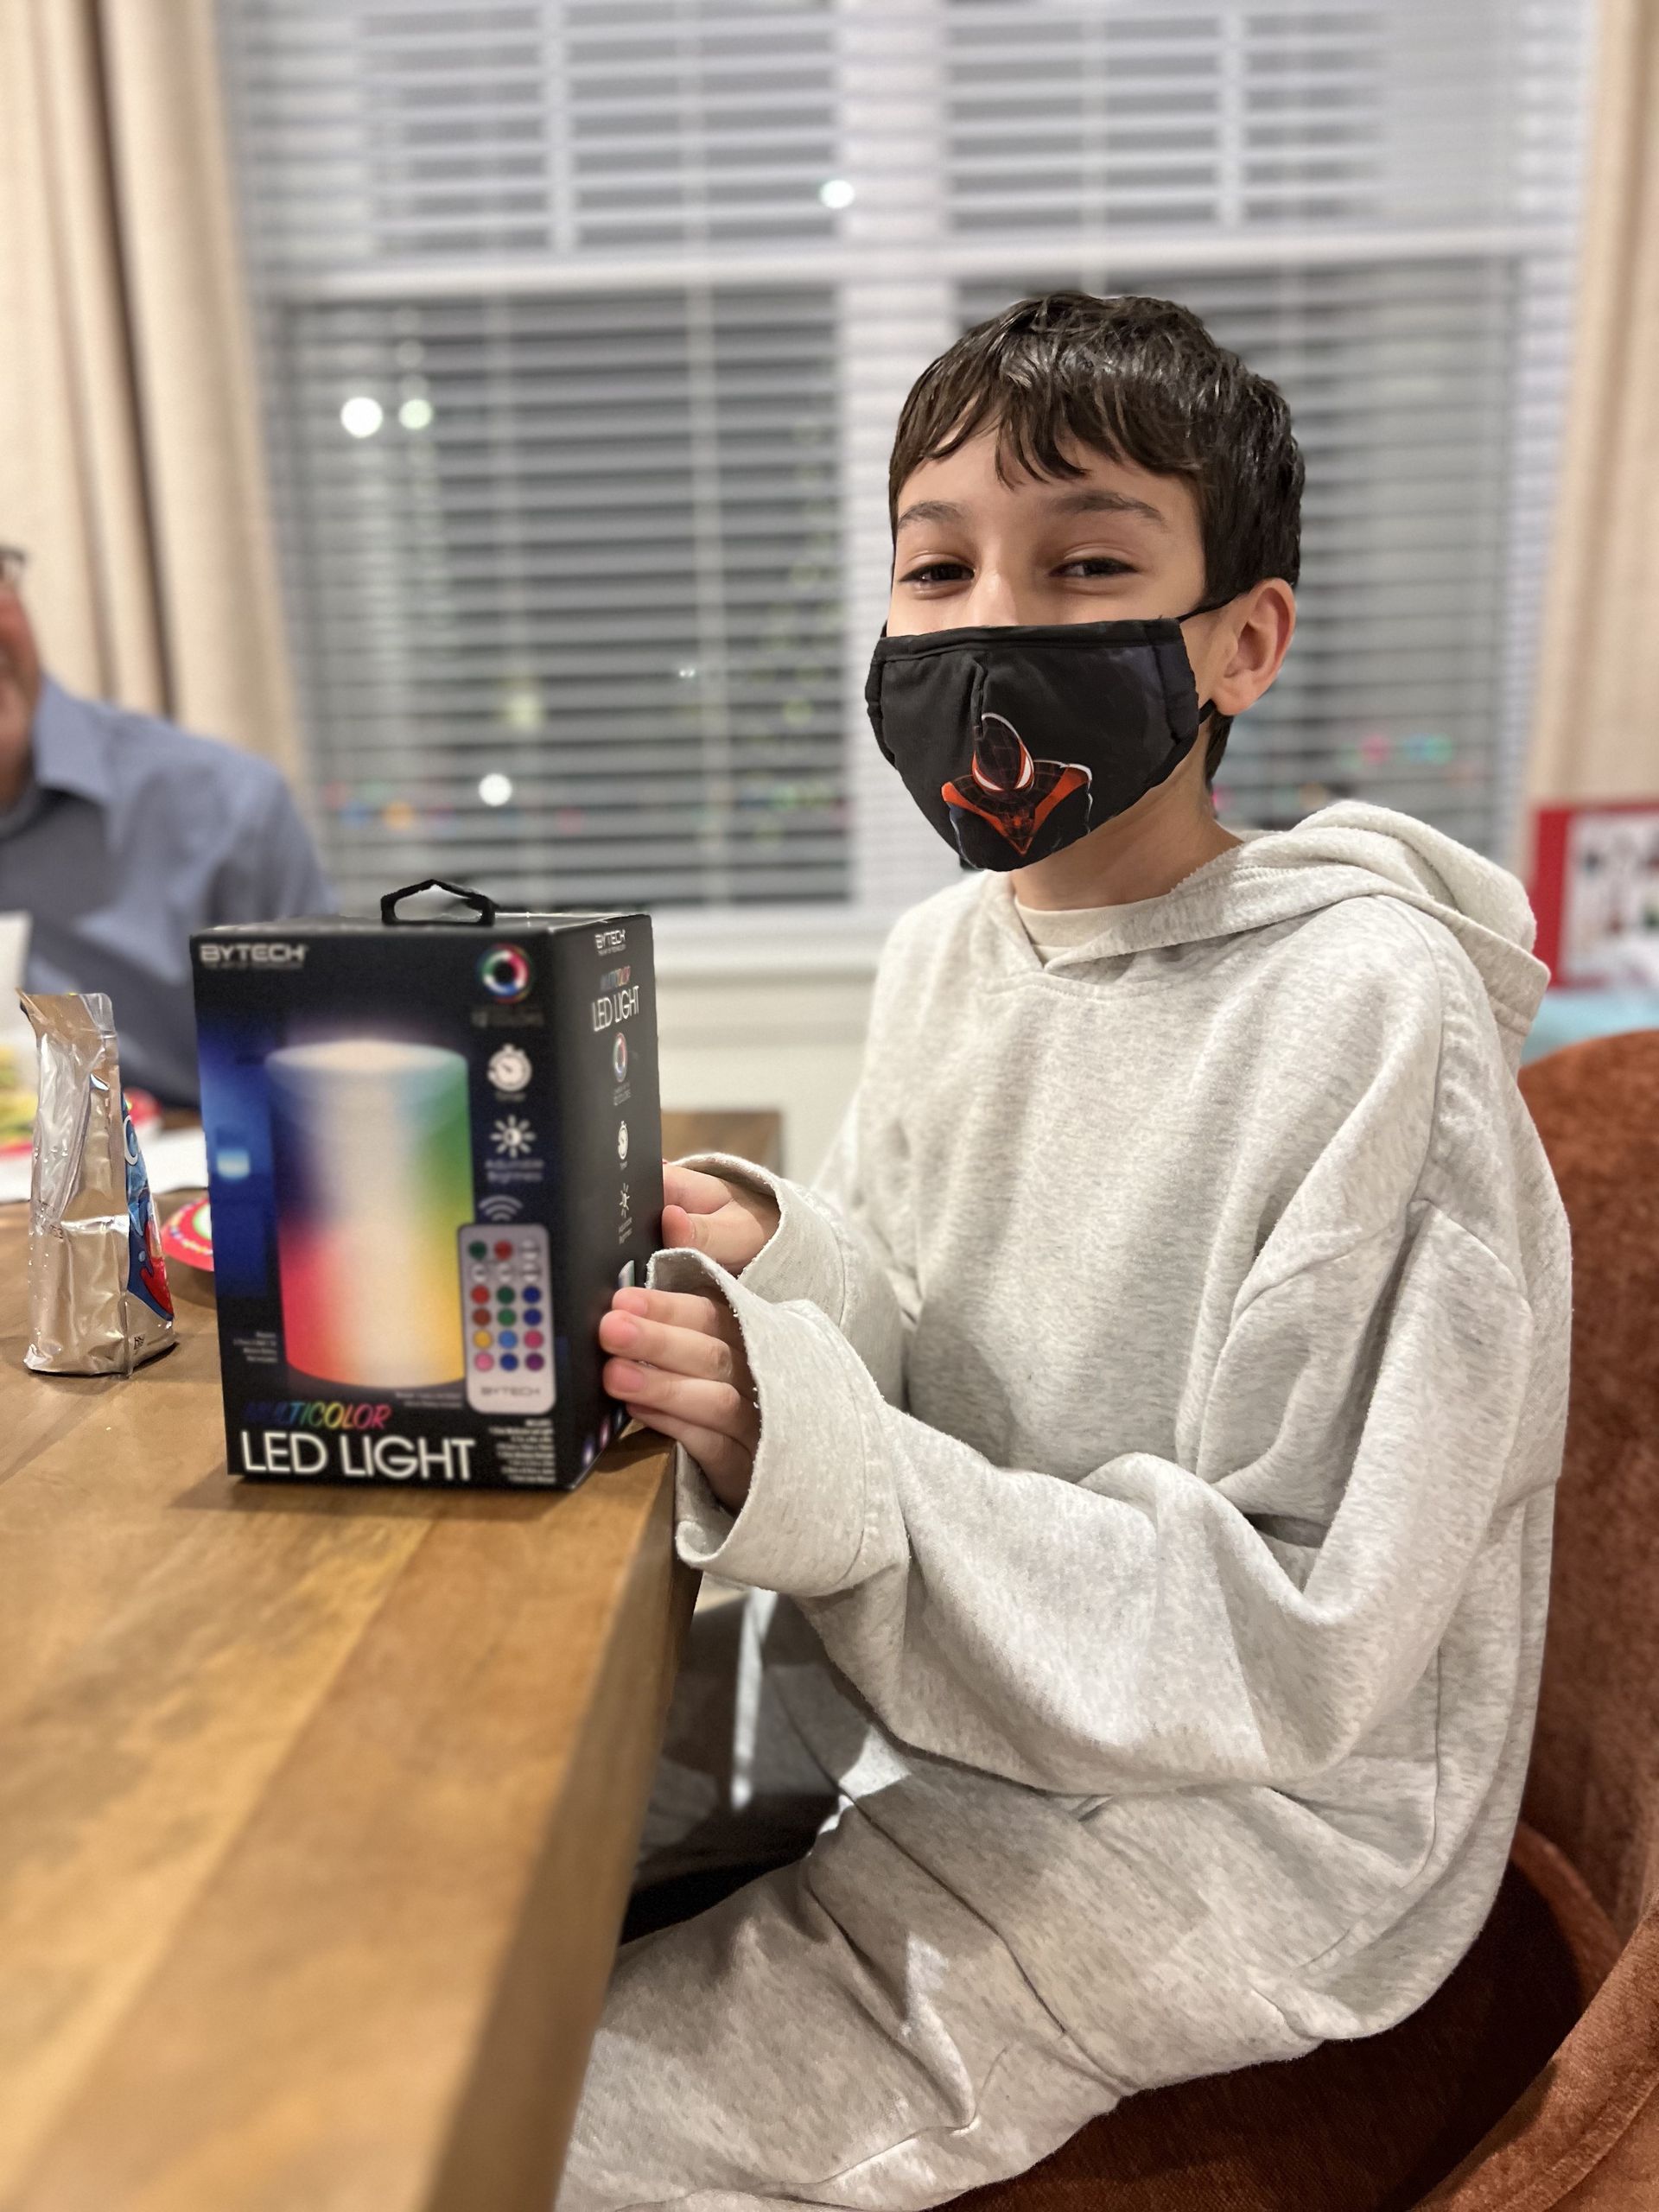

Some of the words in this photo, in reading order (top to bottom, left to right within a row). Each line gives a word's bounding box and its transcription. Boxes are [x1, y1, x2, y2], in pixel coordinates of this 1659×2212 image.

[200, 943, 305, 962] BYTECH
[591, 997, 613, 1032] LED
[613, 985, 639, 1023] LIGHT
[243, 1400, 392, 1429] LTICOLOR
[241, 1430, 328, 1475] LED
[340, 1434, 476, 1480] LIGHT
